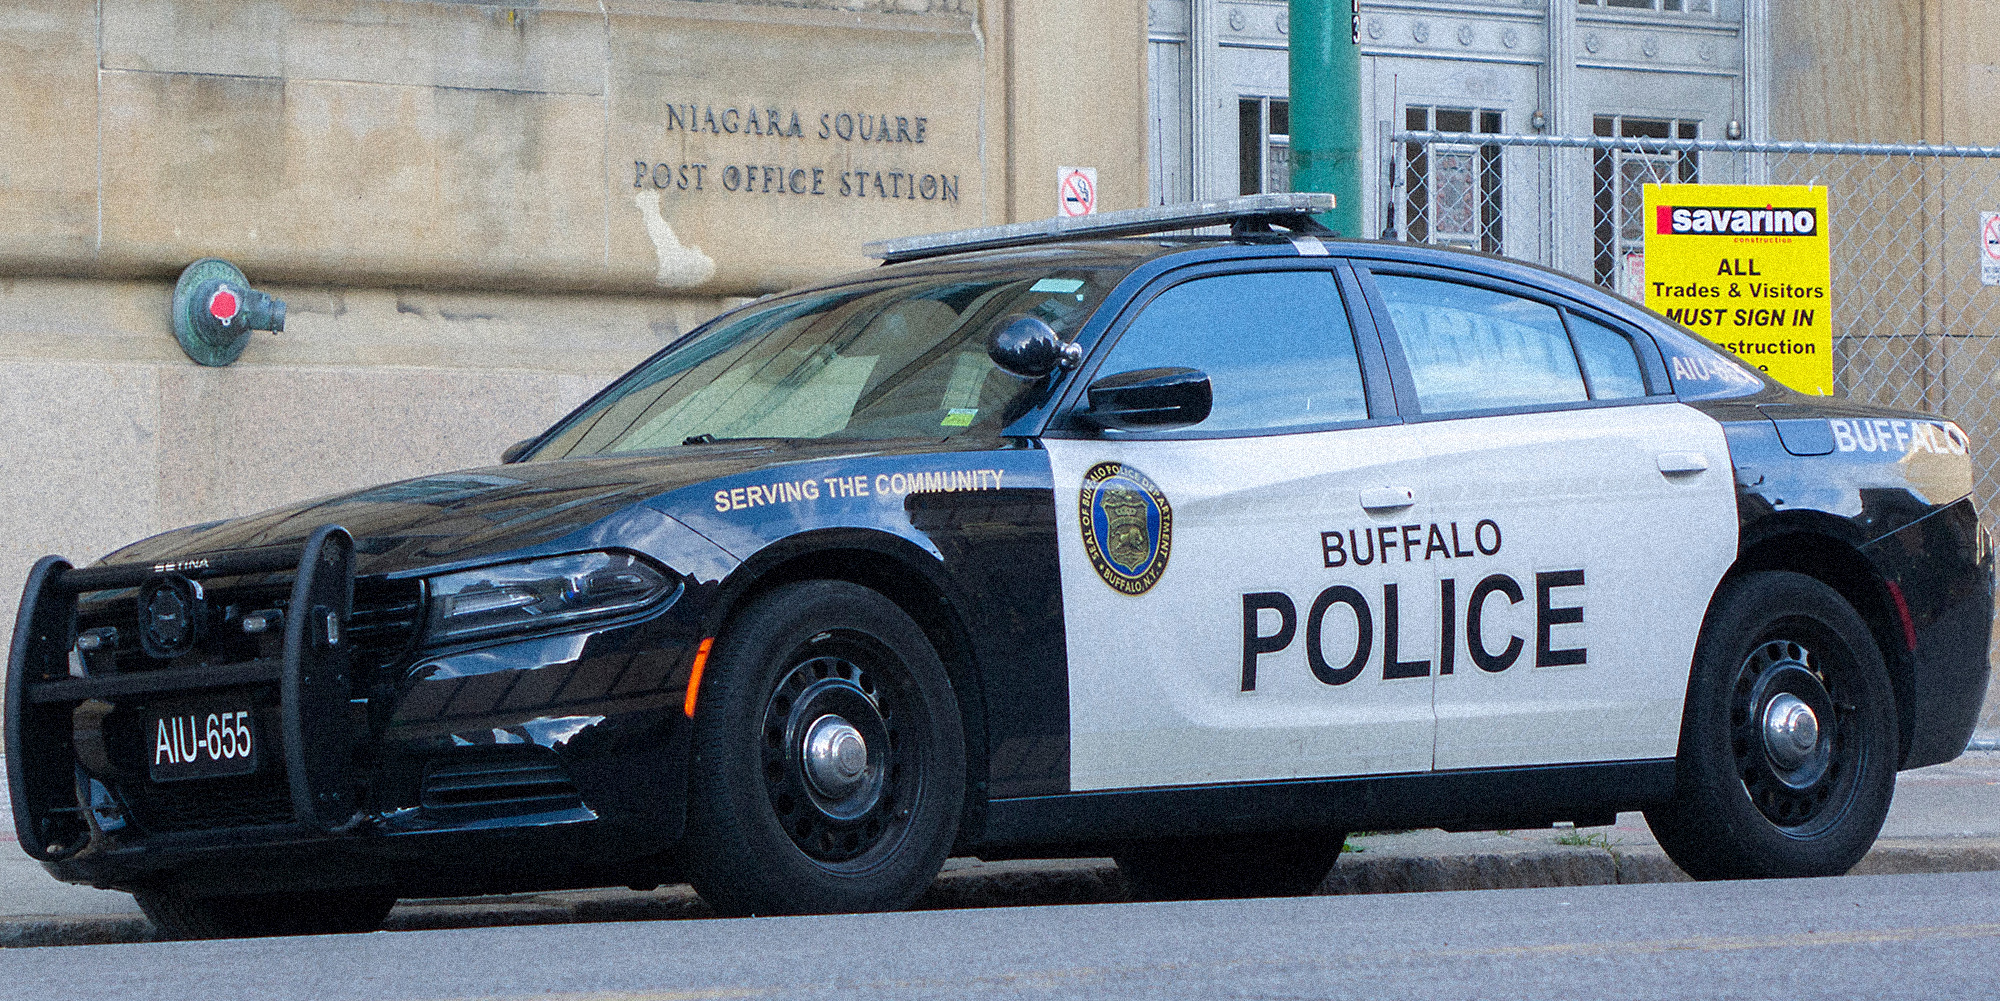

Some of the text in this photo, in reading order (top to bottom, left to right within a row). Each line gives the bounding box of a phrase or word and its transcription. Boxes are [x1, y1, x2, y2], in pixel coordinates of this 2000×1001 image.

[667, 103, 928, 144] NIAGARA SQUARE
[634, 161, 959, 201] POST OFFICE STATION
[1672, 204, 1815, 233] savarino
[1717, 258, 1761, 276] ALL
[1653, 282, 1824, 299] Trades & Visitors
[1666, 308, 1815, 327] MUST SIGN IN
[1830, 420, 1966, 456] BUFFALO
[714, 469, 1004, 512] SERVING THE COMMUNITY
[1081, 464, 1172, 560] SEAL OF BUFFALO POLICE DEPARTMENT
[1320, 518, 1501, 568] BUFFALO
[1241, 569, 1587, 692] POLICE
[155, 711, 251, 765] AIU-655
